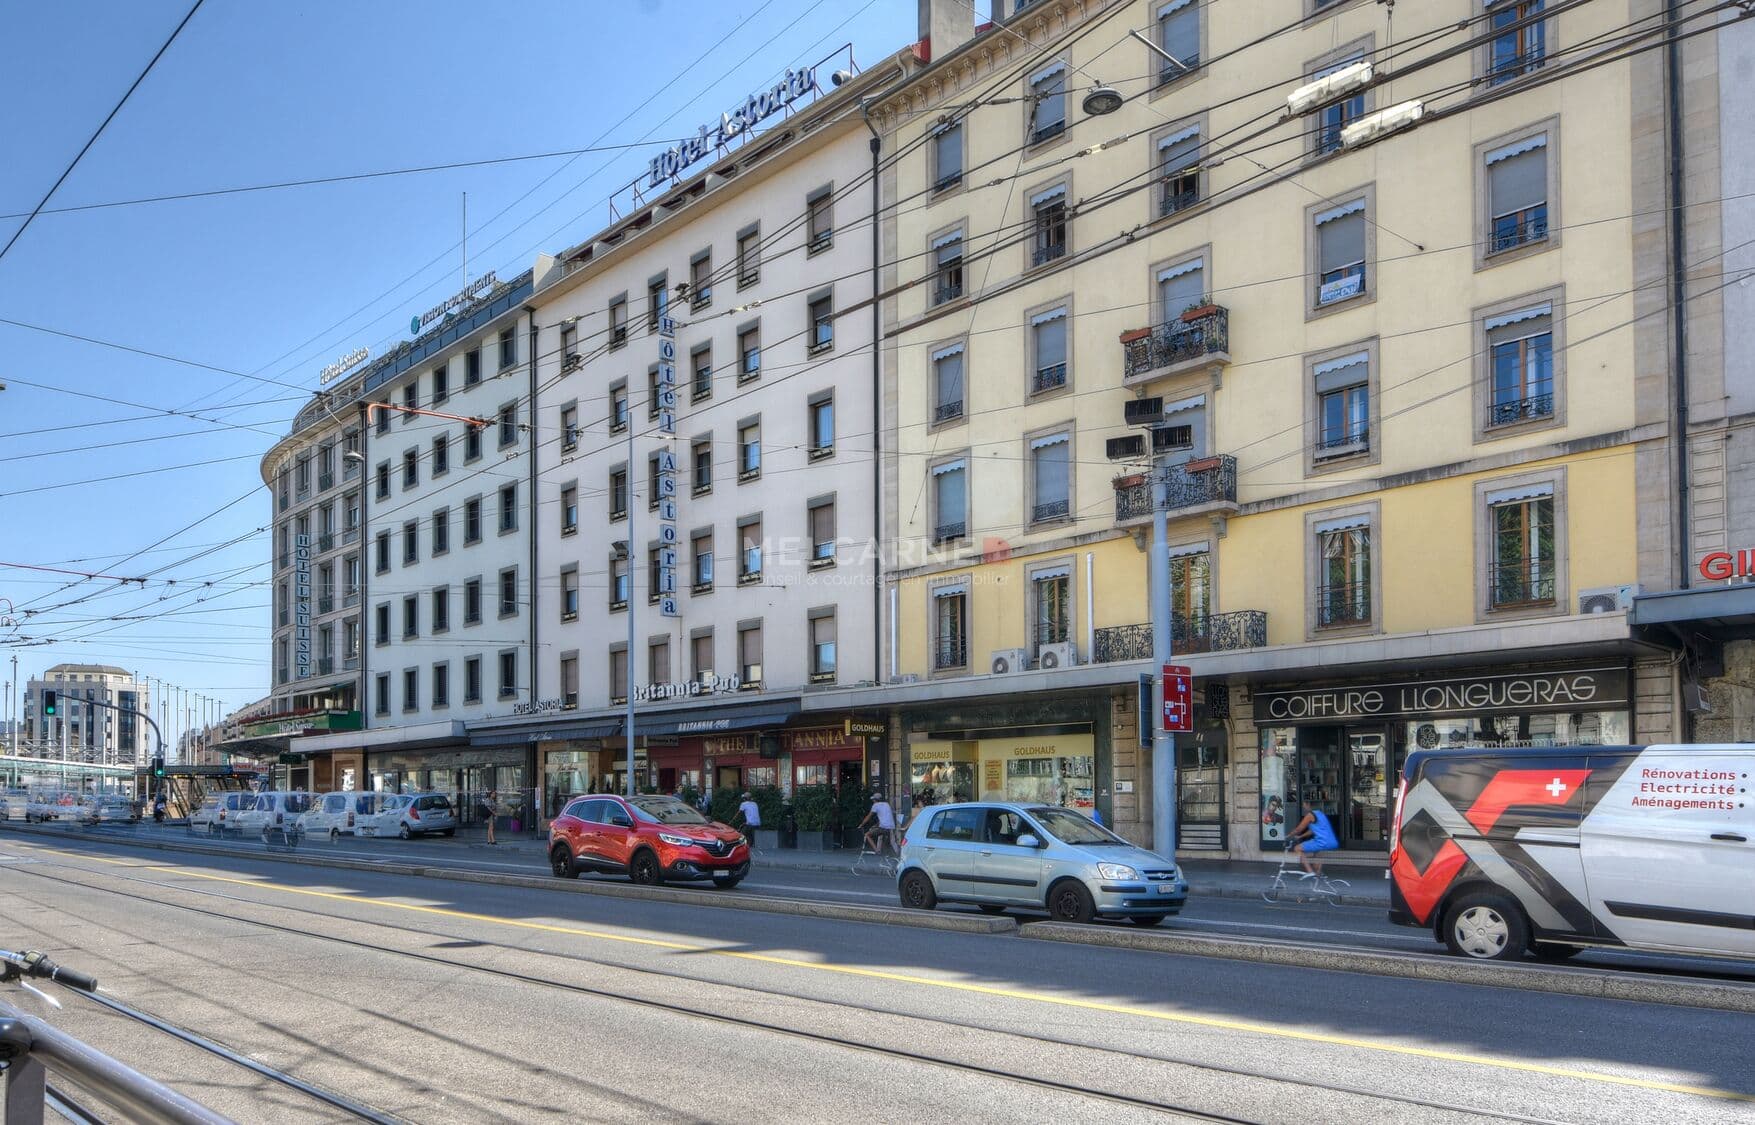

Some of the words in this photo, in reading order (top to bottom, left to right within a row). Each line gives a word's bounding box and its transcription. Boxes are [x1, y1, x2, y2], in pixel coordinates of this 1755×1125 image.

[649, 124, 710, 188] Hôtel
[714, 66, 814, 147] Astoria
[664, 454, 676, 614] Astoria
[299, 603, 309, 677] SUISSE
[709, 672, 740, 692] Pub
[851, 723, 885, 733] GOLDHAUS
[914, 750, 950, 760] GOLDHAUS
[1014, 745, 1056, 756] GOLDHAUS
[1642, 768, 1736, 780] Rénovations
[1640, 783, 1735, 795] Electricité
[1631, 796, 1734, 810] Aménagements
